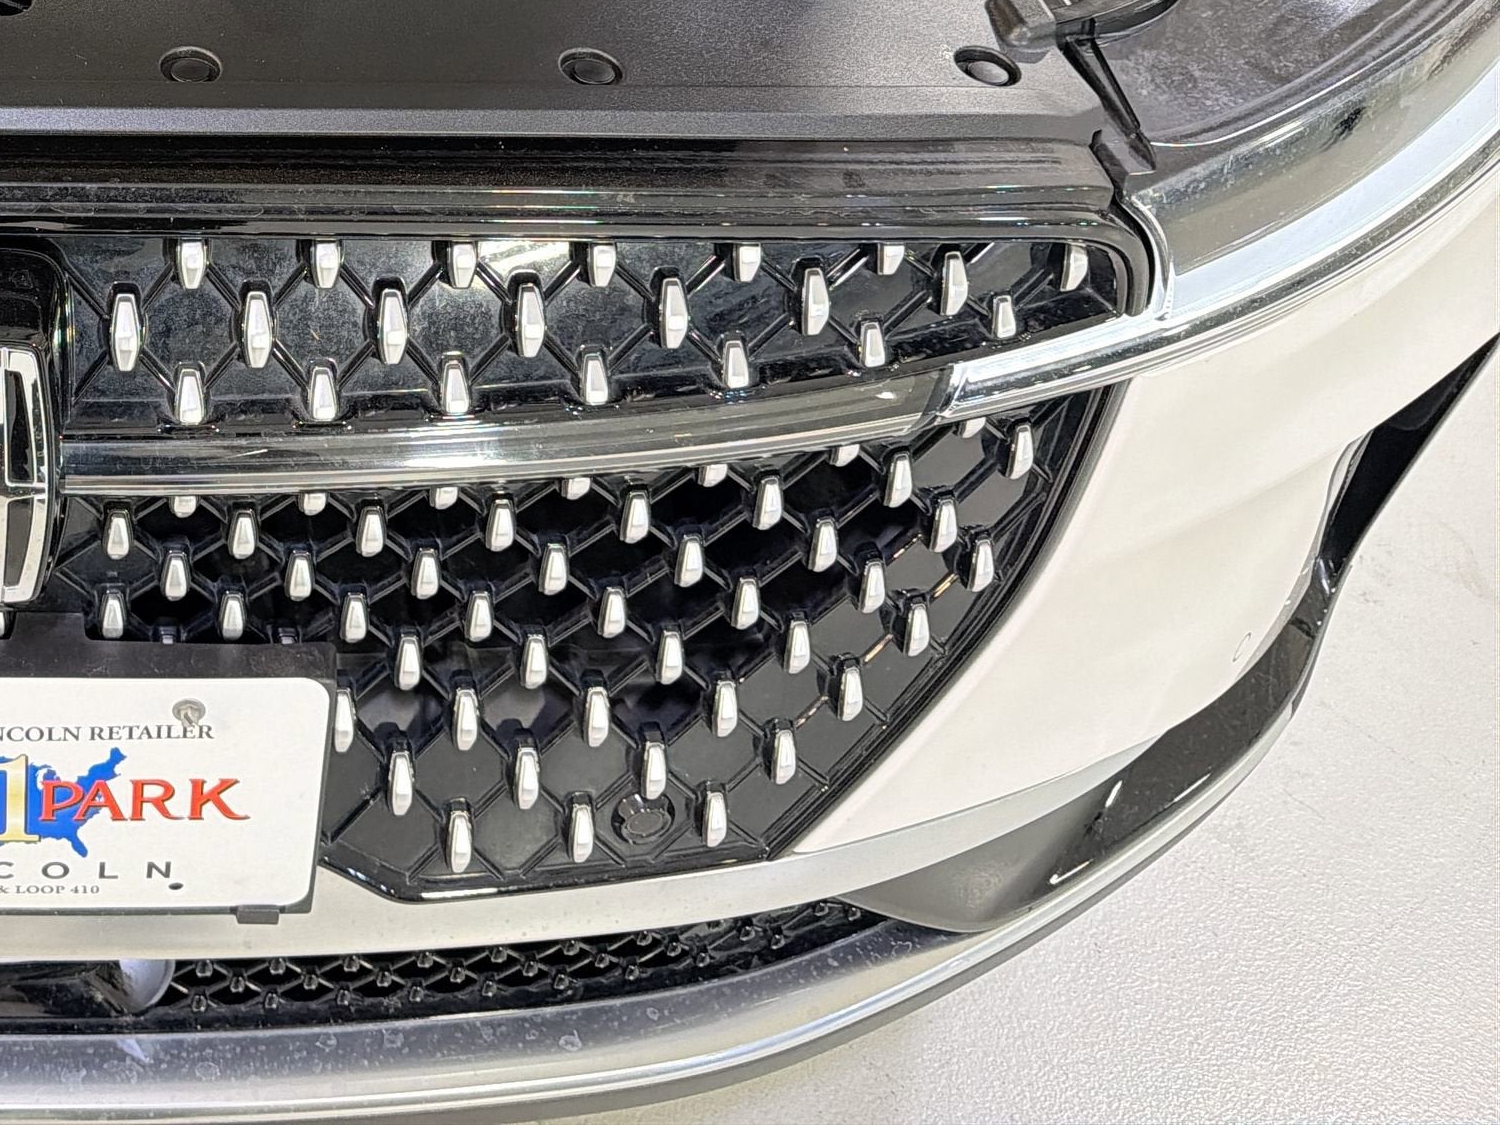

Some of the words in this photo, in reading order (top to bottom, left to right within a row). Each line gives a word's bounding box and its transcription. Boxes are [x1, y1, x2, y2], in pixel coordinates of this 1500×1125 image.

[89, 724, 215, 741] RETAILER
[38, 778, 251, 822] PARK
[16, 885, 65, 894] LOOP
[70, 885, 100, 894] 410
